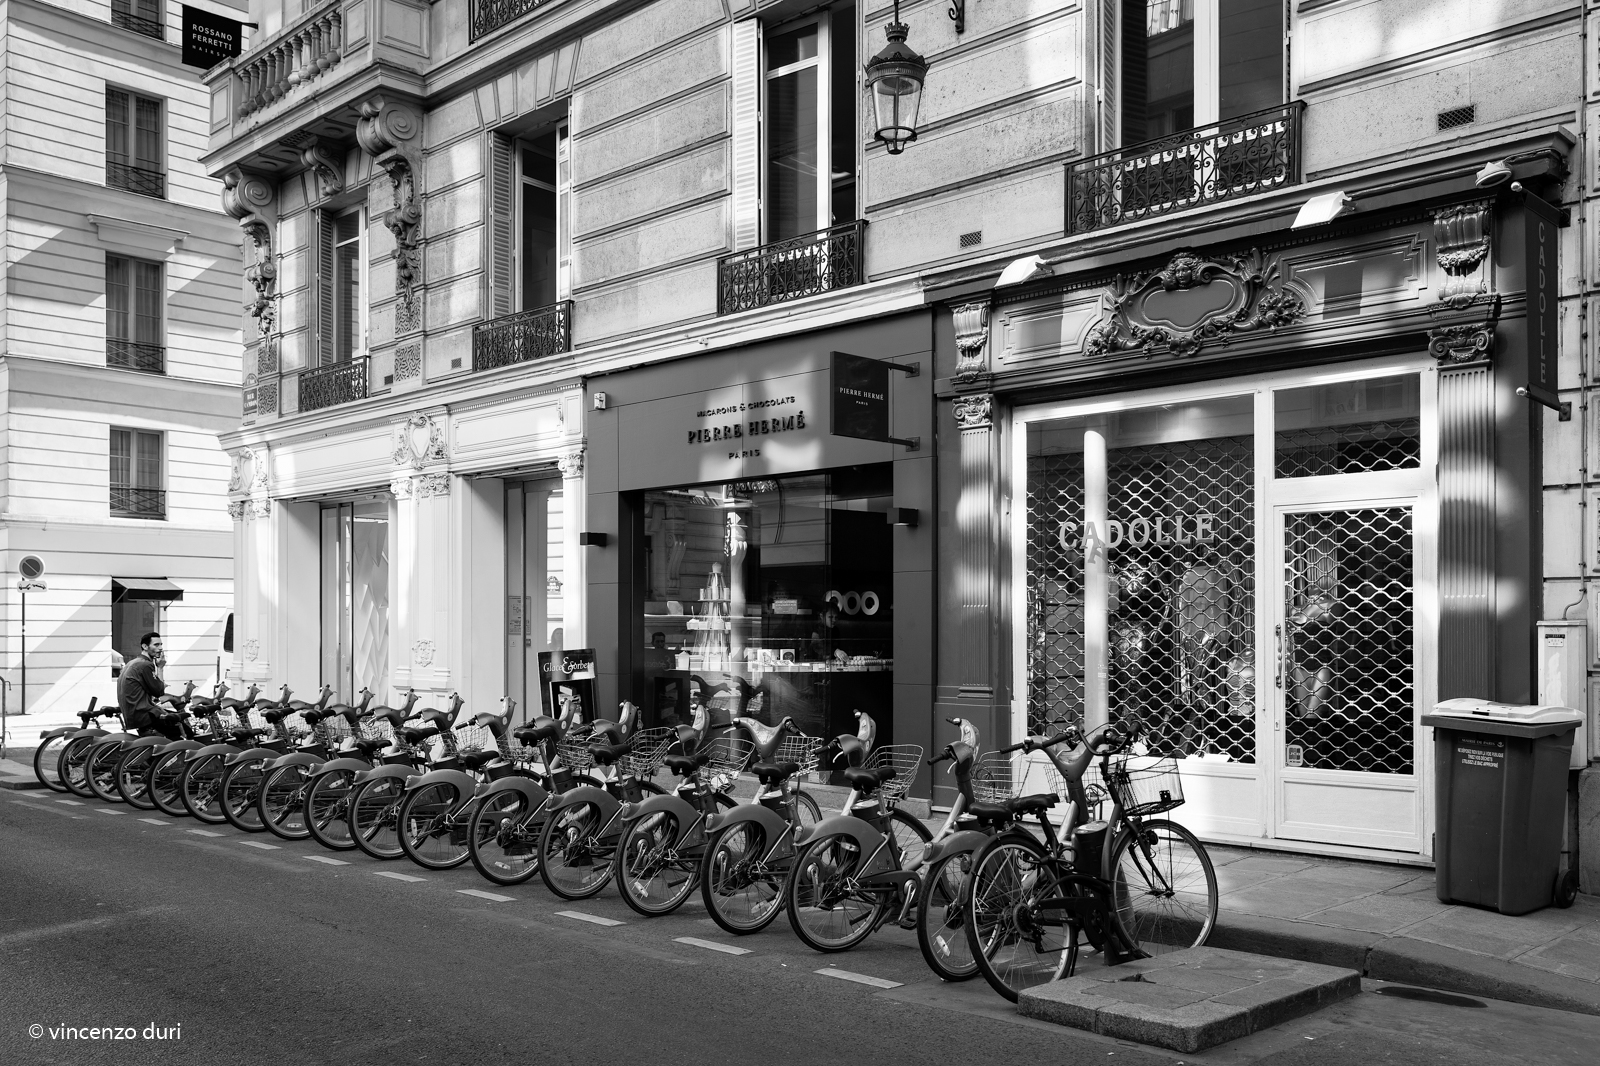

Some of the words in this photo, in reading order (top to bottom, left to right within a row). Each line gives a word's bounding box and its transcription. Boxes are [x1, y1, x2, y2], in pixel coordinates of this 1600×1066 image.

[192, 23, 232, 41] ROSSANO
[192, 33, 232, 51] FERRETTI
[192, 44, 226, 58] HAIRSP
[1538, 221, 1547, 384] CADOLLE
[840, 387, 862, 397] PIERRE
[863, 391, 884, 401] HERMÉ
[697, 405, 738, 418] MACARONS
[739, 403, 746, 412] &
[747, 396, 796, 410] CHOCOLATS
[687, 423, 743, 445] PIERRE
[748, 410, 806, 436] HERMÉ
[728, 449, 761, 460] PARIS
[1059, 513, 1215, 551] CADOLLE
[562, 656, 574, 675] &
